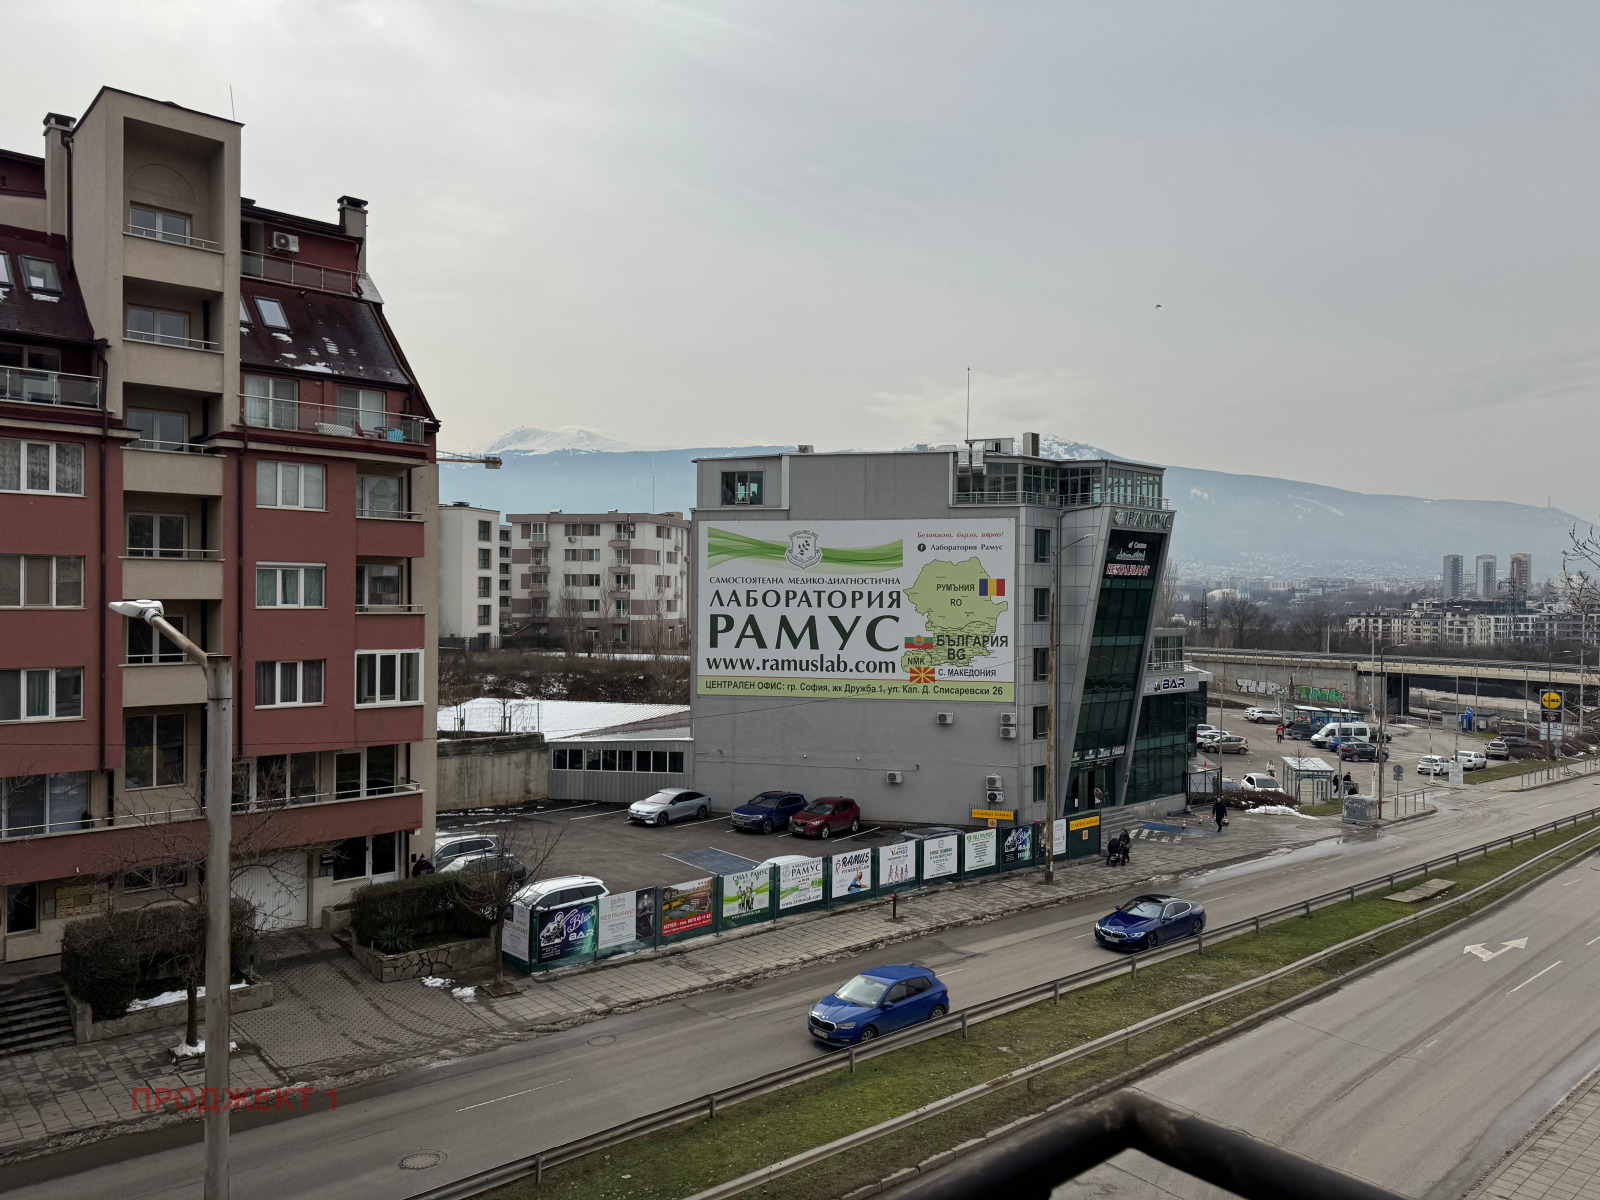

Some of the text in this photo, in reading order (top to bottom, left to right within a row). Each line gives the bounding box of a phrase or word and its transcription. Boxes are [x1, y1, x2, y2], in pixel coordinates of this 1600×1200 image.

[981, 544, 1004, 552] Рамус
[709, 576, 901, 585] САМОСТОЯТЕЛНА МЕДИКО-ДИАГНОСТИЧНА
[936, 584, 974, 592] РУМЪНИЯ
[710, 589, 901, 608] ЛАБОРАТОРИЯ
[950, 598, 962, 606] RO
[710, 614, 900, 652] РАМУС
[936, 634, 1008, 648] БЪЛГАРИЯ
[948, 648, 966, 660] BG
[706, 654, 896, 673] www.ramuslab.com
[908, 658, 926, 666] NMK
[948, 669, 996, 678] МАКЕДОНИЯ
[706, 681, 754, 690] ЦЕНТРАЛЕН
[757, 681, 784, 690] ОФИС:
[787, 684, 798, 692] гр.
[800, 682, 830, 692] София,
[844, 684, 876, 694] Дружба
[888, 686, 900, 695] ул.
[902, 685, 920, 694] Кап.
[922, 686, 930, 694] Д.
[934, 686, 990, 696] Списаревски
[992, 686, 1003, 696] 26
[1162, 678, 1186, 690] BAR
[842, 852, 870, 868] RAMUS
[792, 863, 821, 877] РАМУС
[569, 929, 594, 941] BAR
